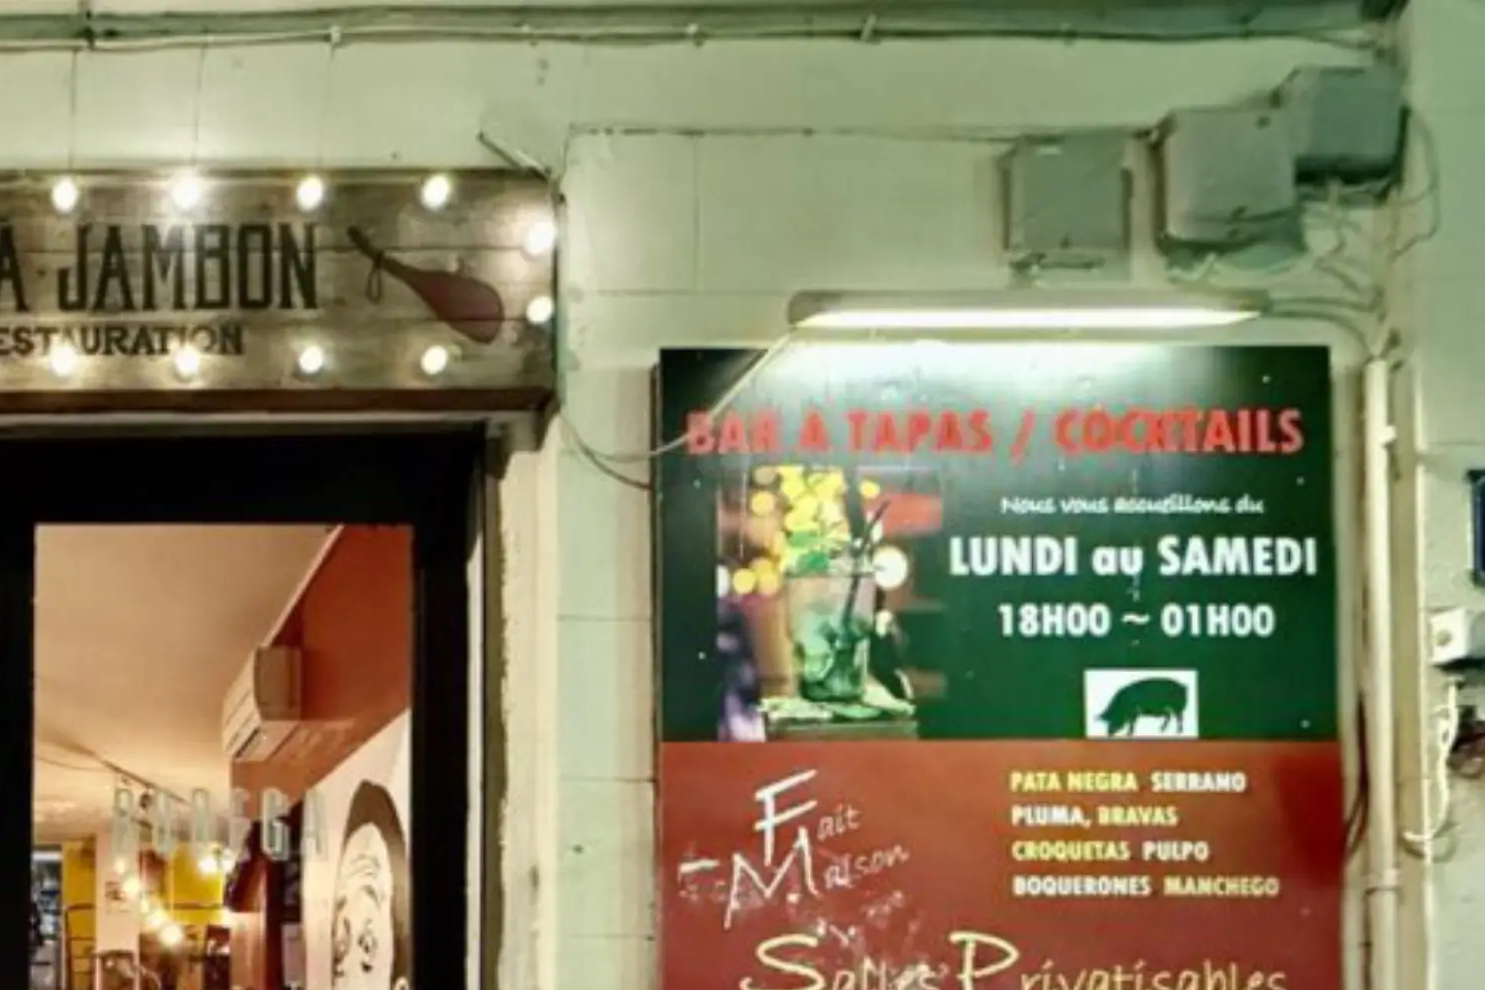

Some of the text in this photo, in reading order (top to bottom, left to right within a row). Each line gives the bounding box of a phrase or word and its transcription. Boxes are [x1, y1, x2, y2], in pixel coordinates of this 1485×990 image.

[57, 222, 318, 311] JAMBON
[686, 410, 779, 454] BAR
[846, 408, 993, 452] TAPAS
[1055, 407, 1304, 454] COCKTAILS
[949, 536, 1318, 578] LUNDI au SAMEDI
[998, 604, 1111, 638] 18H00
[1160, 603, 1275, 637] 01H00
[1010, 771, 1248, 793] PATA NEGRA SERRANO
[1098, 805, 1179, 826] BRAVAS
[1011, 840, 1210, 862] CROQUETAS PULPO
[1012, 874, 1281, 897] BOQUERONES MANCHEGO
